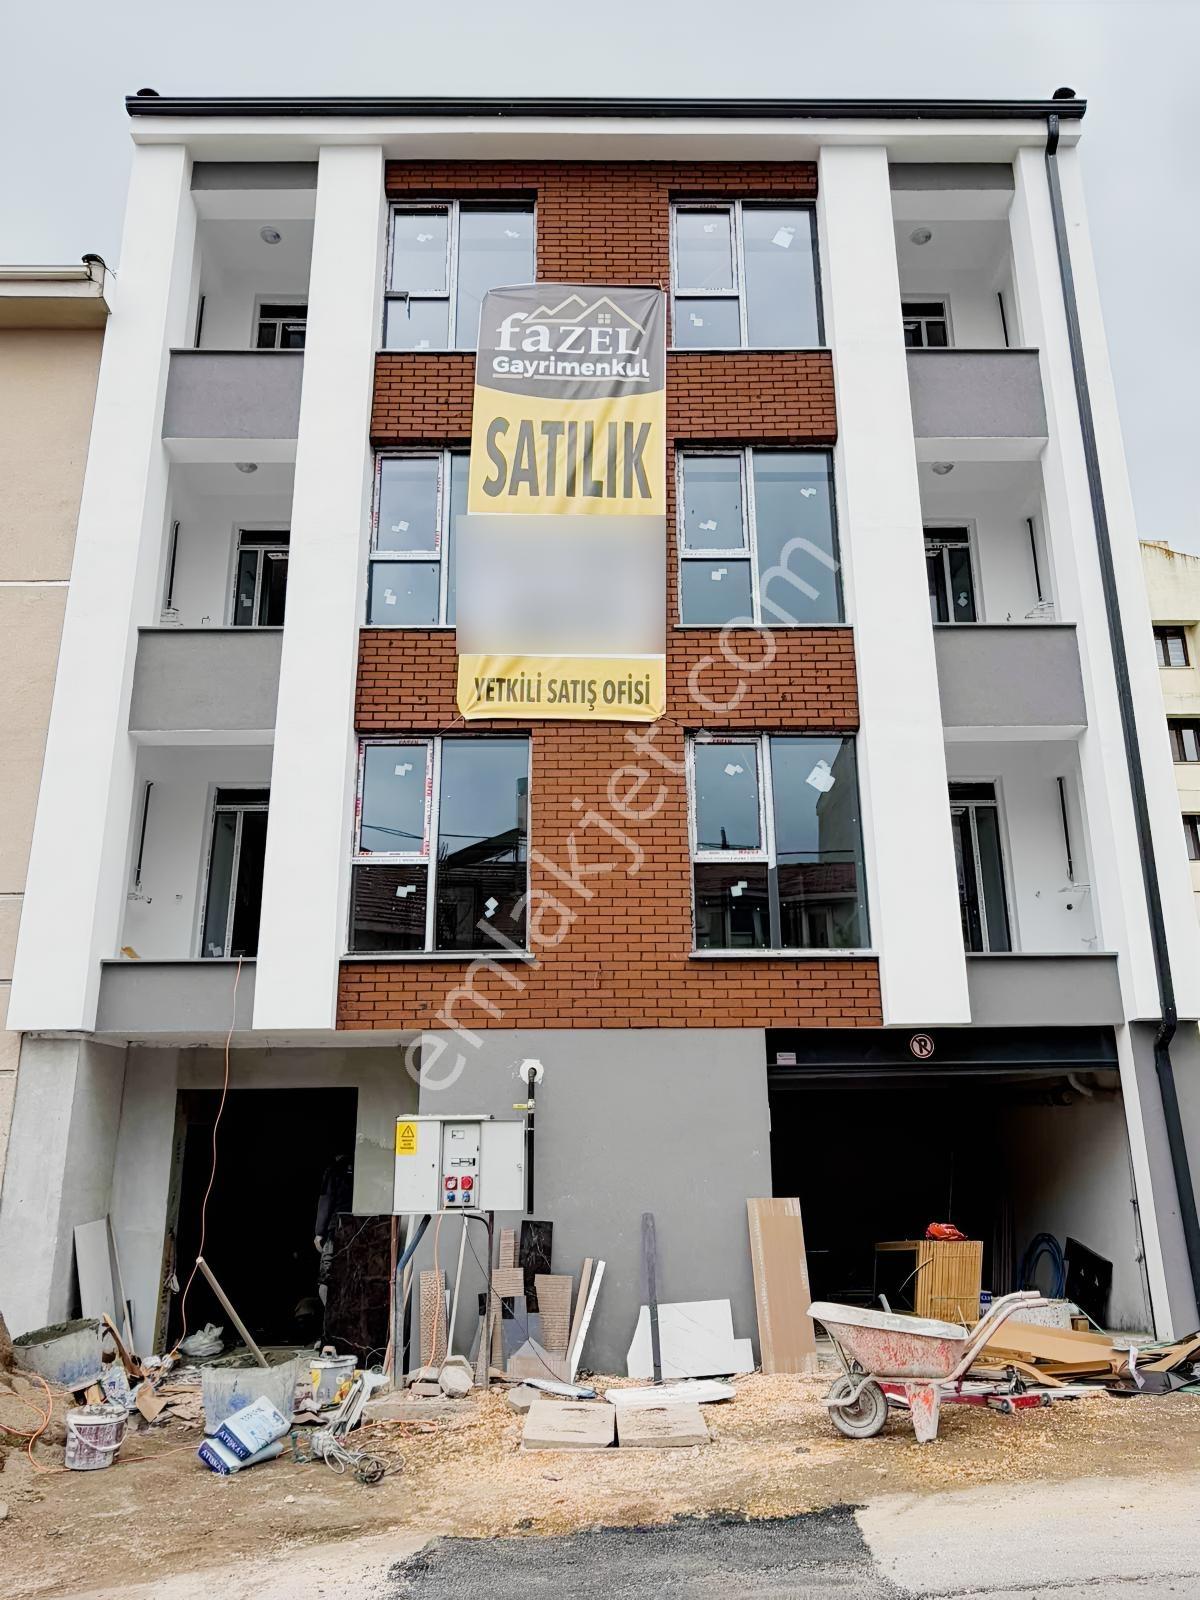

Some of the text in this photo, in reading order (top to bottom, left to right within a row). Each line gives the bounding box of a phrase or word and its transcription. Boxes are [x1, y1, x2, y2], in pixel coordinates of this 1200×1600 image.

[492, 355, 650, 378] Gayrimenkul
[482, 416, 653, 499] SATILIK
[474, 671, 650, 711] YETKİLİ SATIŞ OFİSİ
